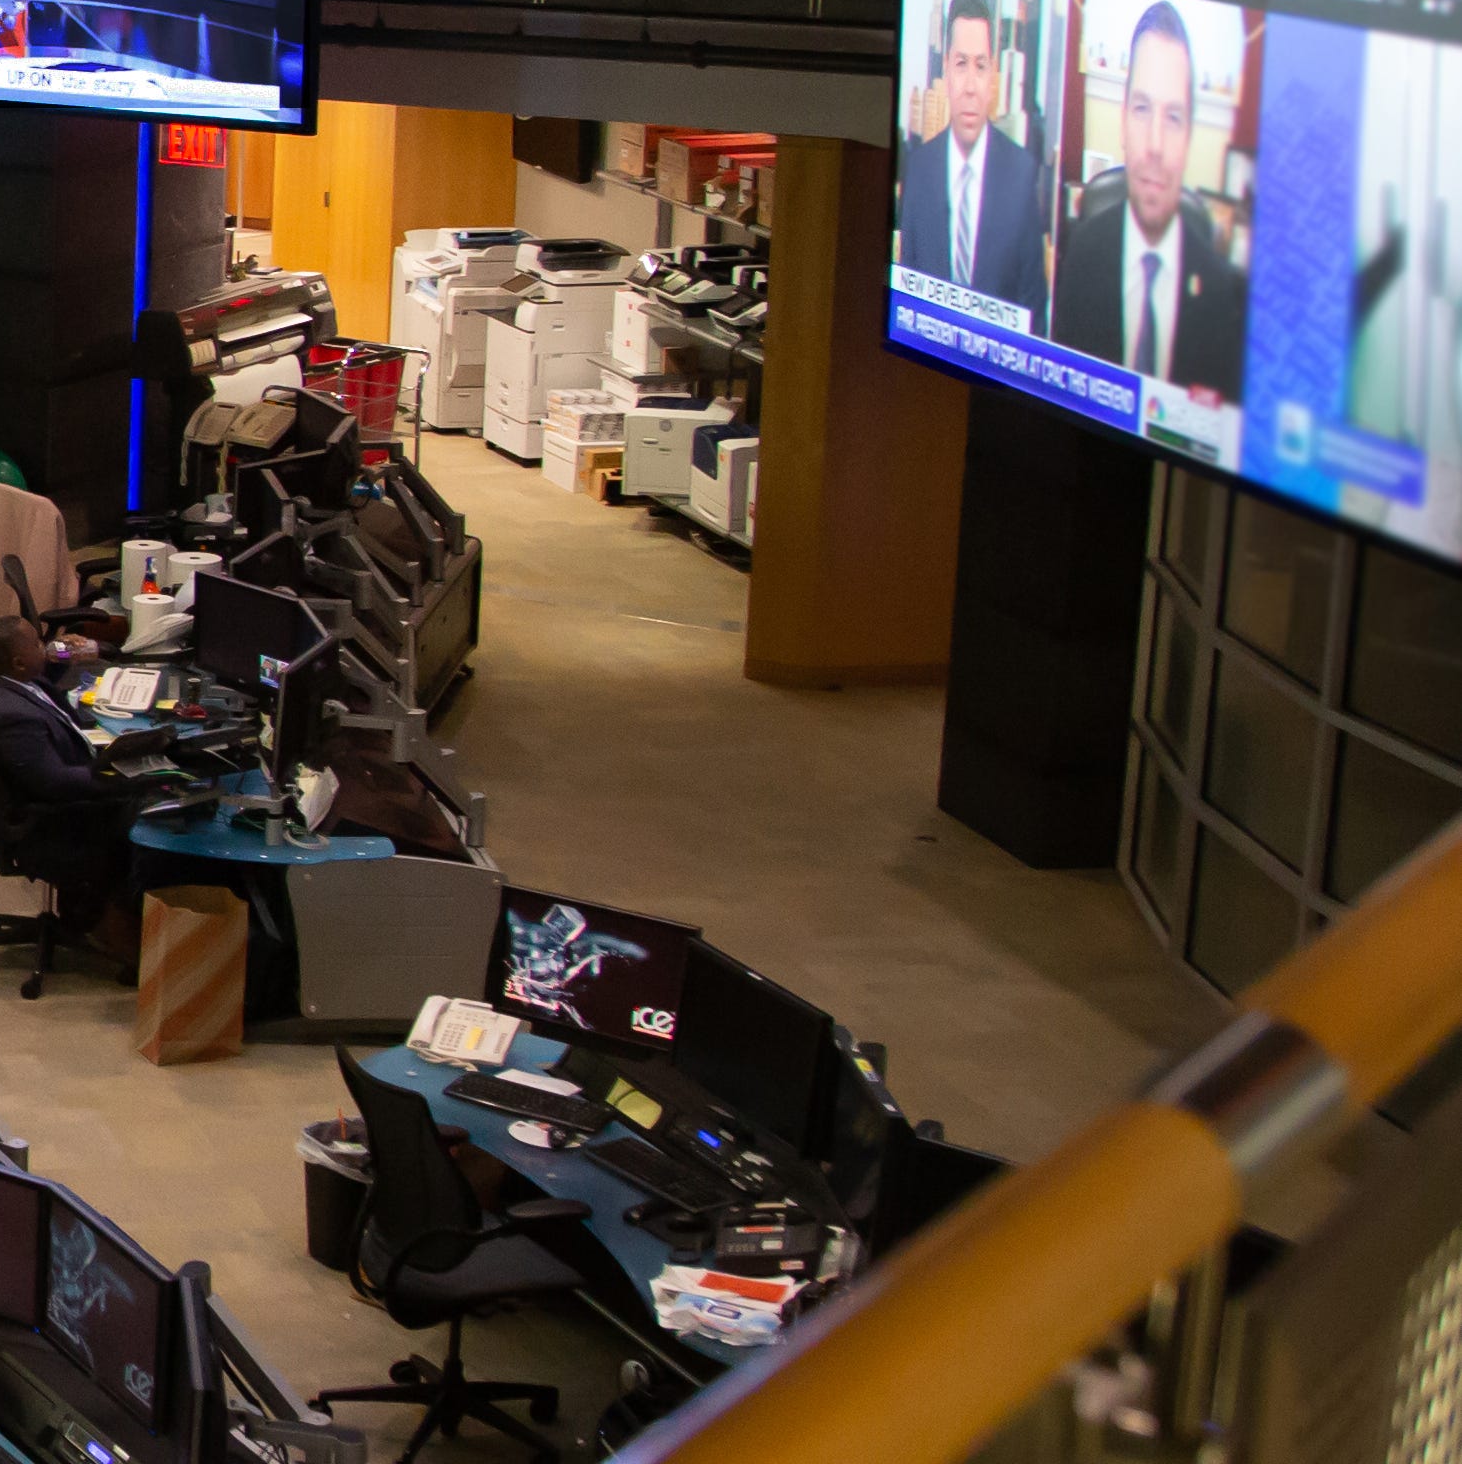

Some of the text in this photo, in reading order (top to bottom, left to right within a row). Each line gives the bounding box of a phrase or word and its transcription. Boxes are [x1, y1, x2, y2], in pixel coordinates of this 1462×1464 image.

[168, 122, 221, 163] EXIT
[900, 271, 1020, 330] NEW DEVELOPMENTS
